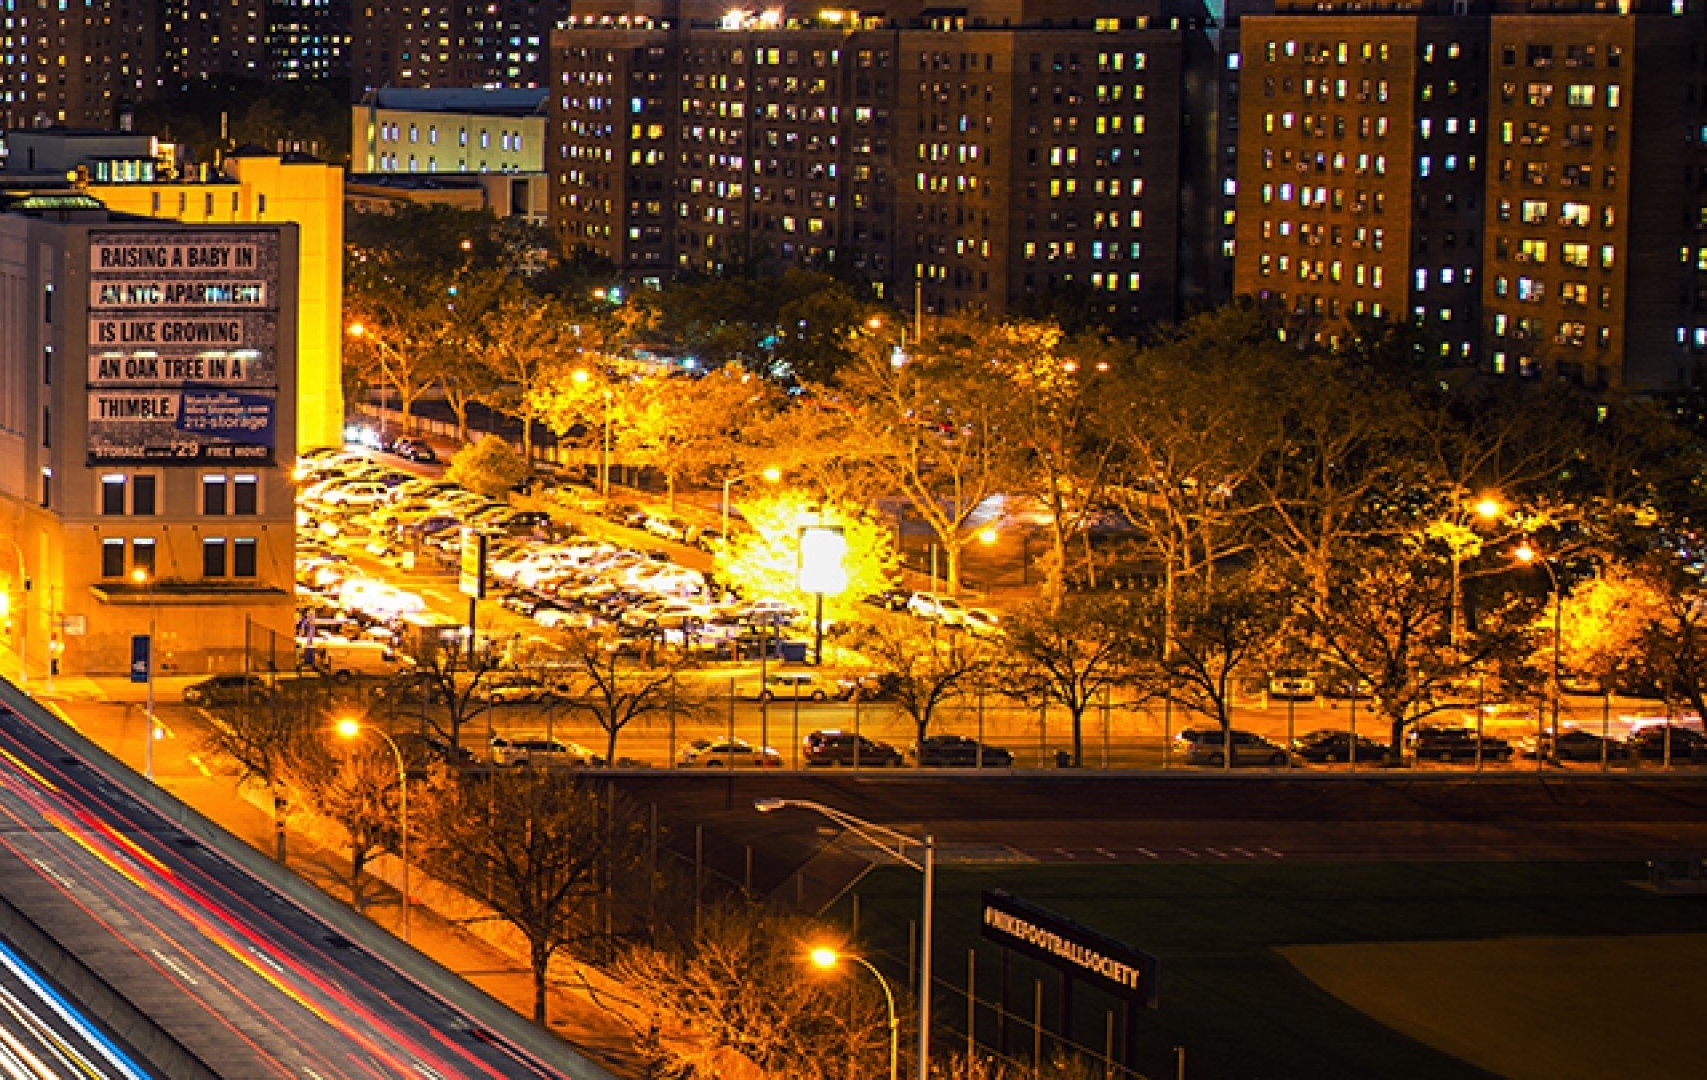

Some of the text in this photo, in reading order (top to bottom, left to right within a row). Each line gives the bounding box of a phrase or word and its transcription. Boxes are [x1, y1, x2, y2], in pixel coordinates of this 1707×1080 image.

[101, 247, 252, 267] RAISING A BABY IN
[99, 284, 262, 305] AN NYC APARTMENT
[98, 322, 239, 342] IS LIKE GROWING
[98, 359, 242, 379] AN OAK TREE IN A
[99, 398, 175, 417] THIMBLE.
